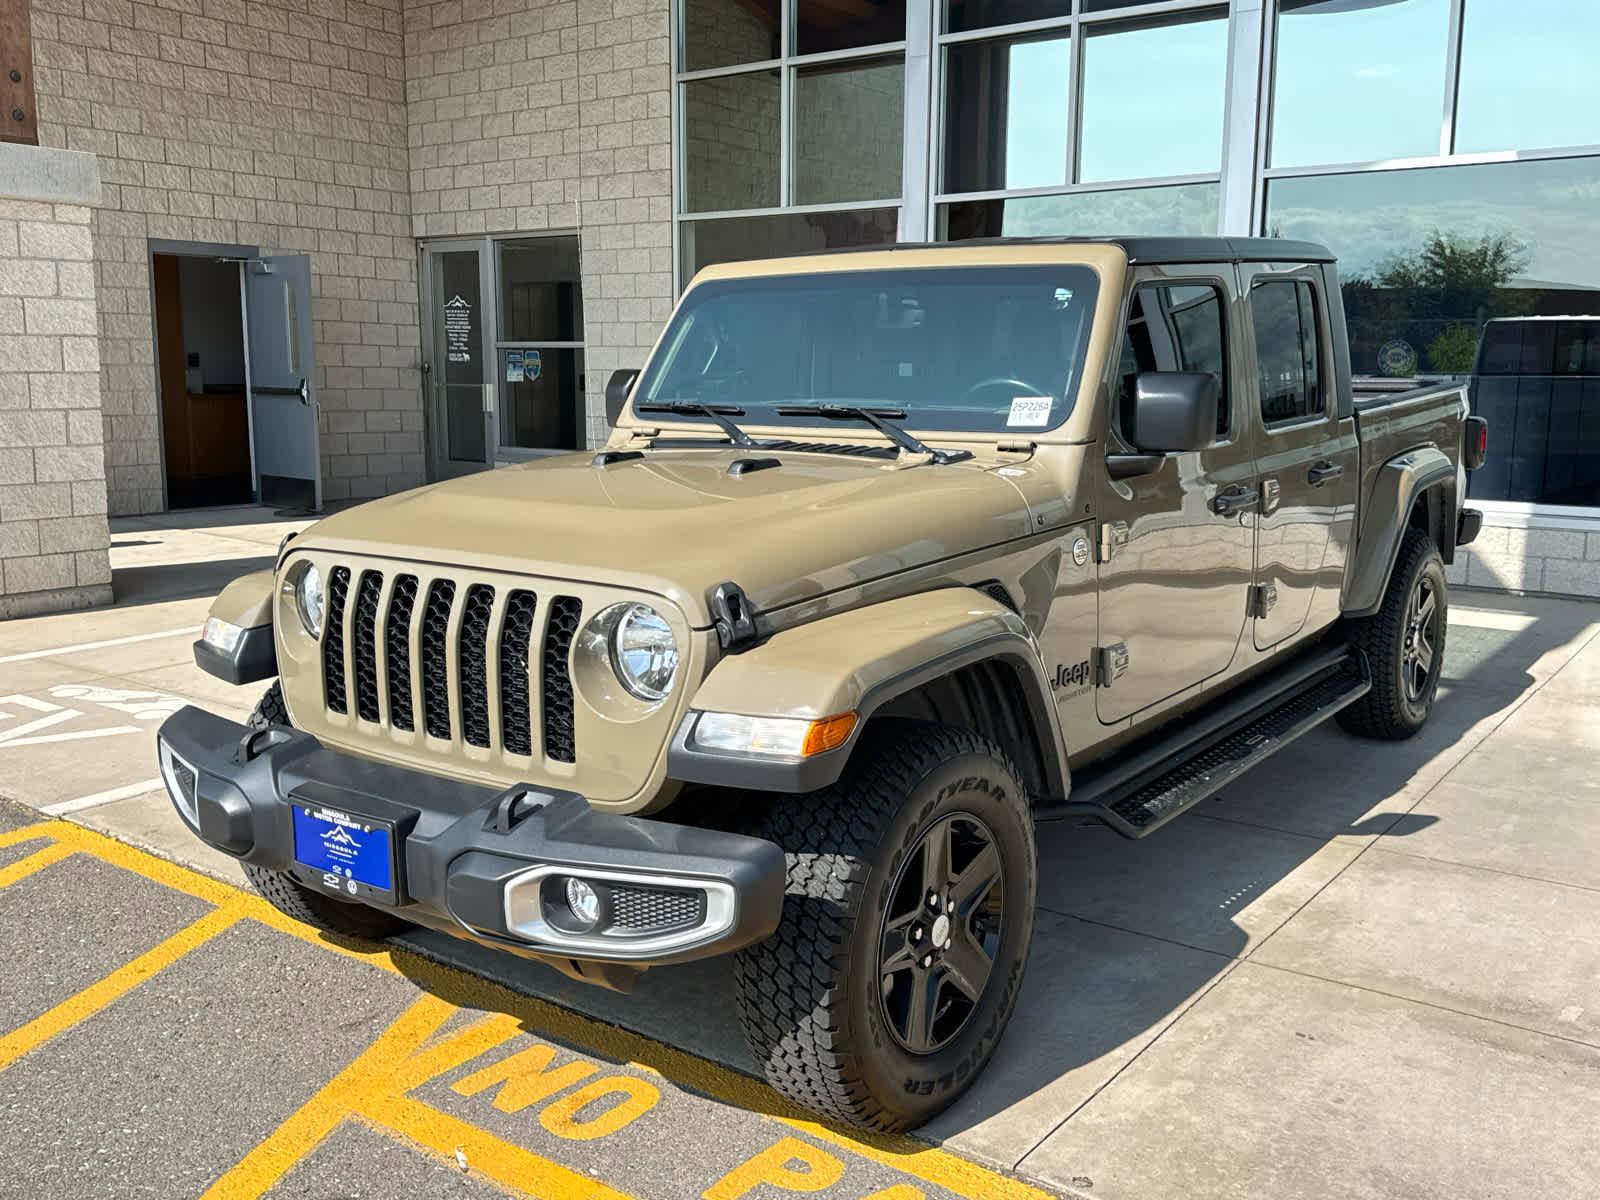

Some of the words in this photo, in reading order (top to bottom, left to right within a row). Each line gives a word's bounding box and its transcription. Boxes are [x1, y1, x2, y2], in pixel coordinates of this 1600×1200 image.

[1049, 660, 1090, 691] Jeep
[879, 776, 1006, 913] GOODYEAR
[449, 1044, 661, 1141] NO
